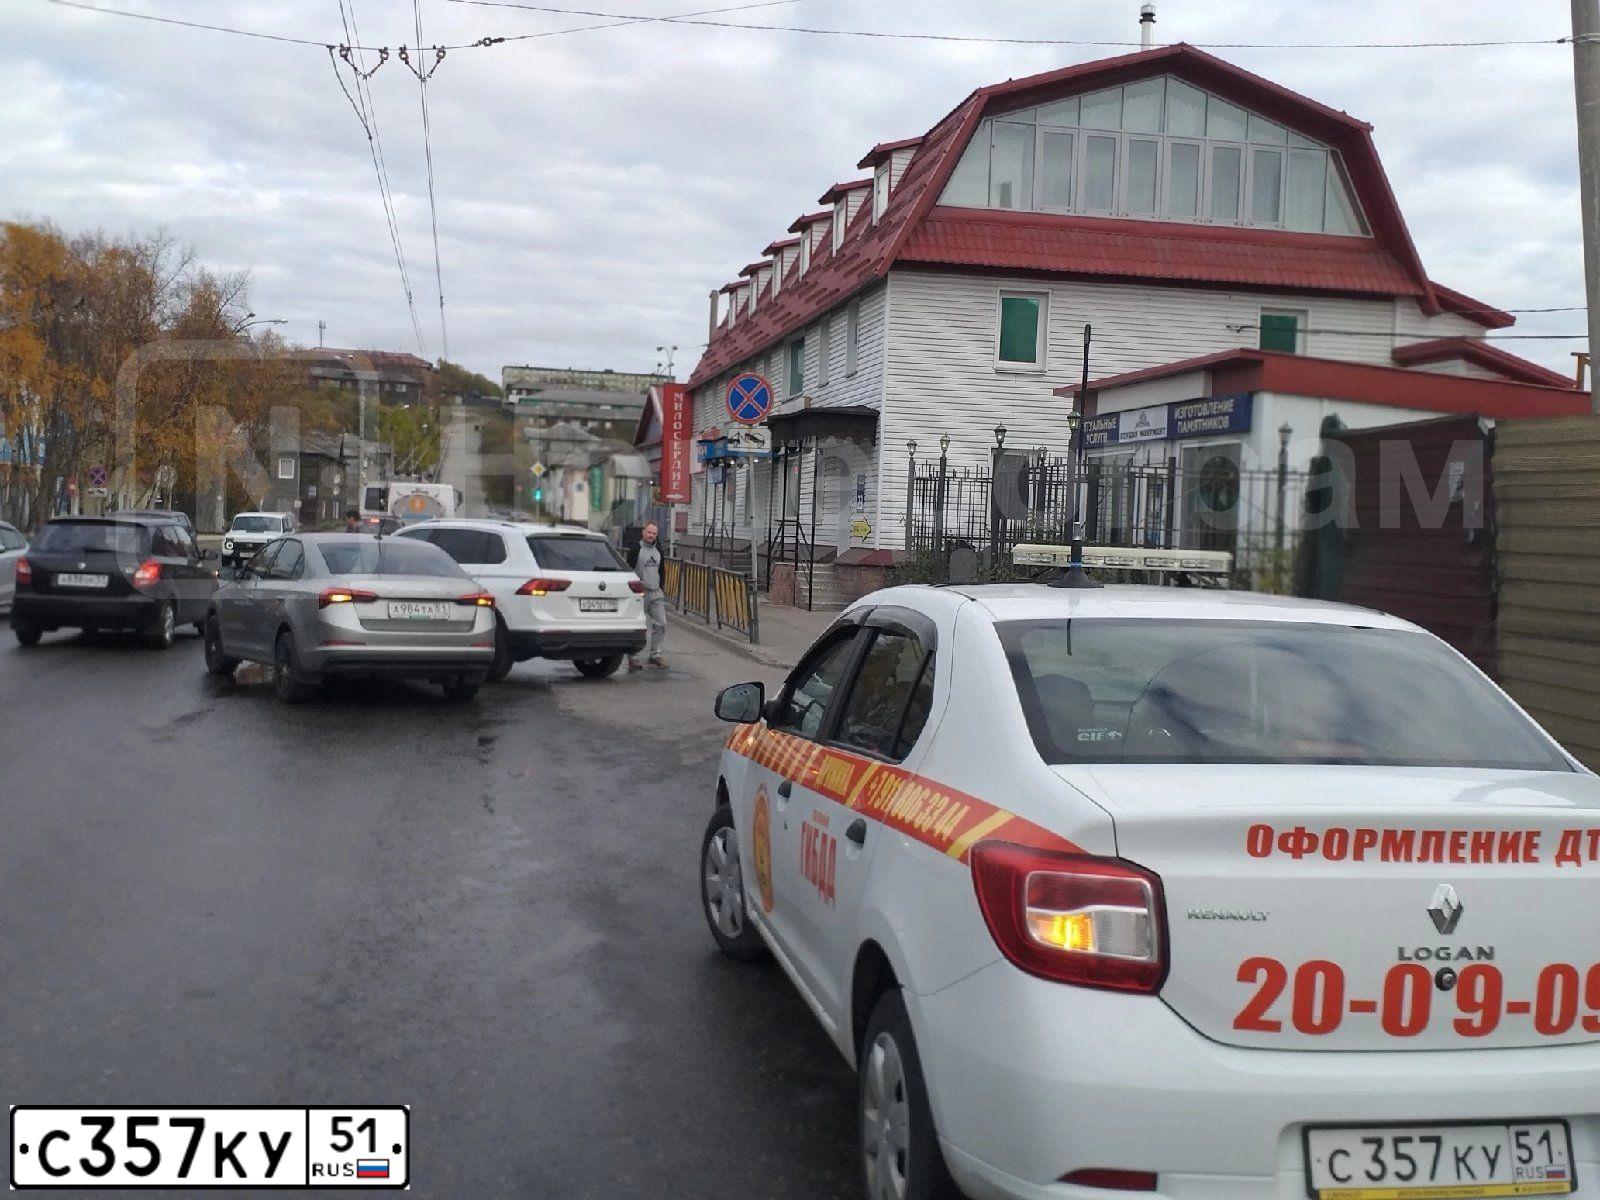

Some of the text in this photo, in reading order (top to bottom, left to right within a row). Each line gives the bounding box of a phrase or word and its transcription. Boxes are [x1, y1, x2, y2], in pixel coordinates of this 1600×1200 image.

[1174, 399, 1235, 418] ИЗГОТОВЛЕНИЕ
[1177, 415, 1230, 434] ПАМЯТНИКОВ
[672, 392, 684, 491] МИЛОСЕРДИЕ
[1086, 432, 1109, 445] УСЛУГИ
[1246, 823, 1542, 865] ОФОРМЛЕНИЕ
[1187, 908, 1271, 922] RENAULT
[1397, 945, 1496, 962] LOGAN
[1514, 1129, 1555, 1165] 51
[1516, 1166, 1544, 1180] RUS
